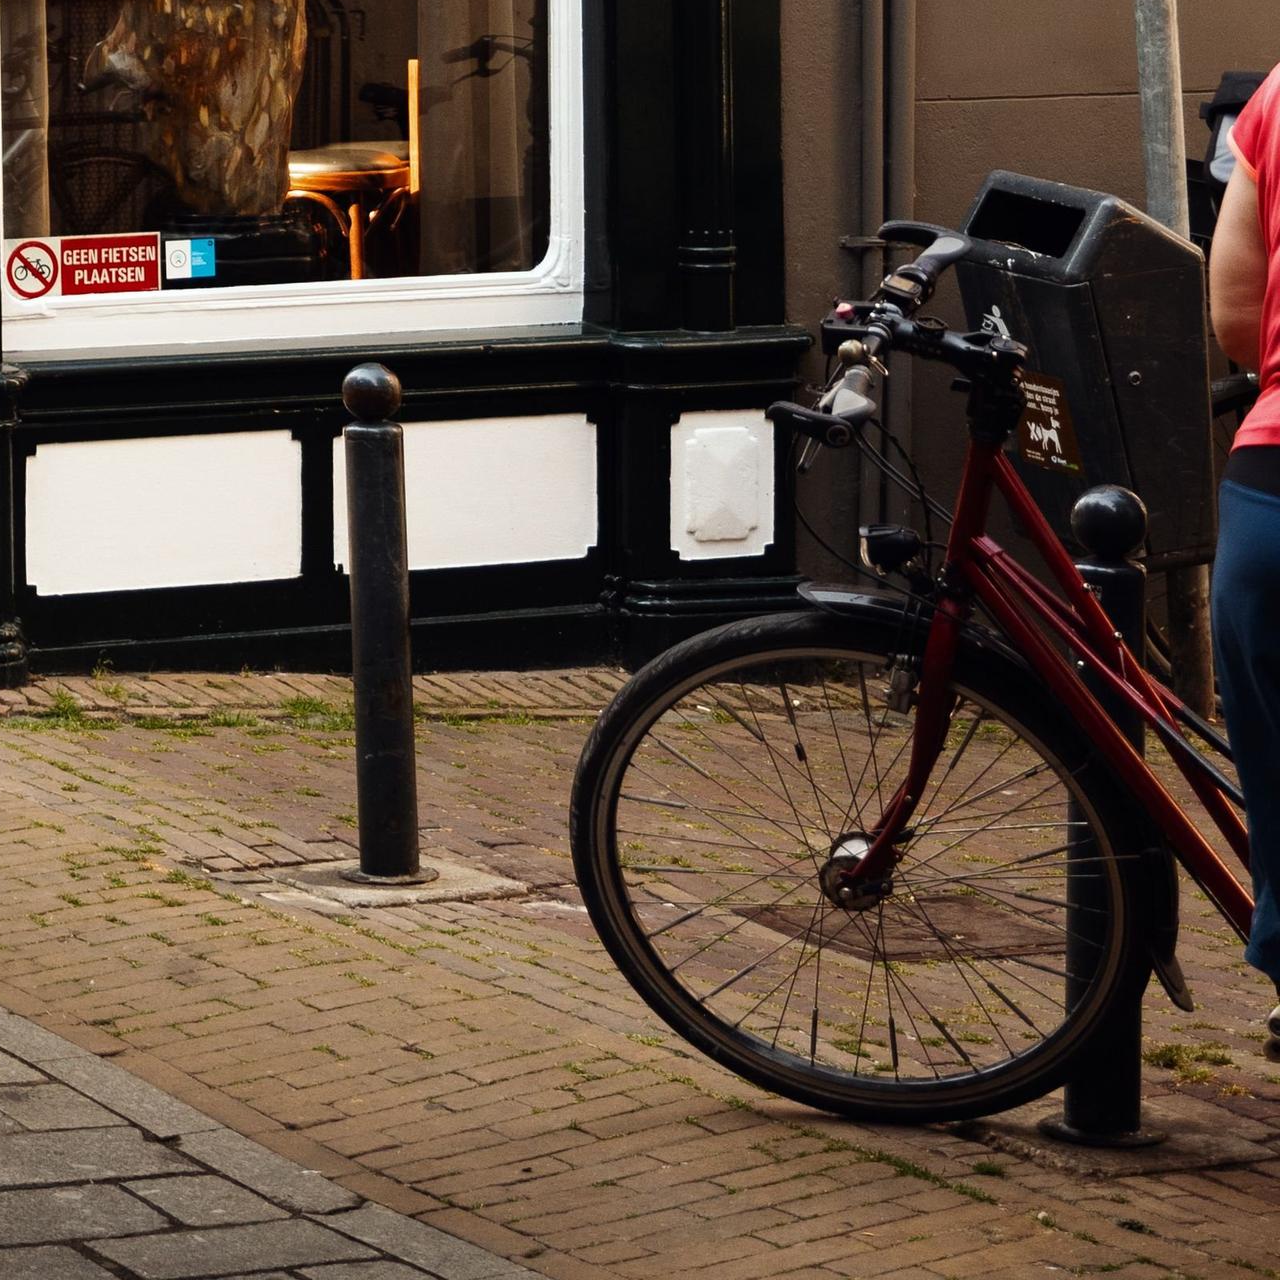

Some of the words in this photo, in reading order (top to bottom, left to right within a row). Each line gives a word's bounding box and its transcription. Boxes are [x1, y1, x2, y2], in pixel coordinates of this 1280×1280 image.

[63, 249, 98, 265] GEEN
[101, 246, 156, 263] FIETSEN
[74, 267, 145, 285] PLAATSEN
